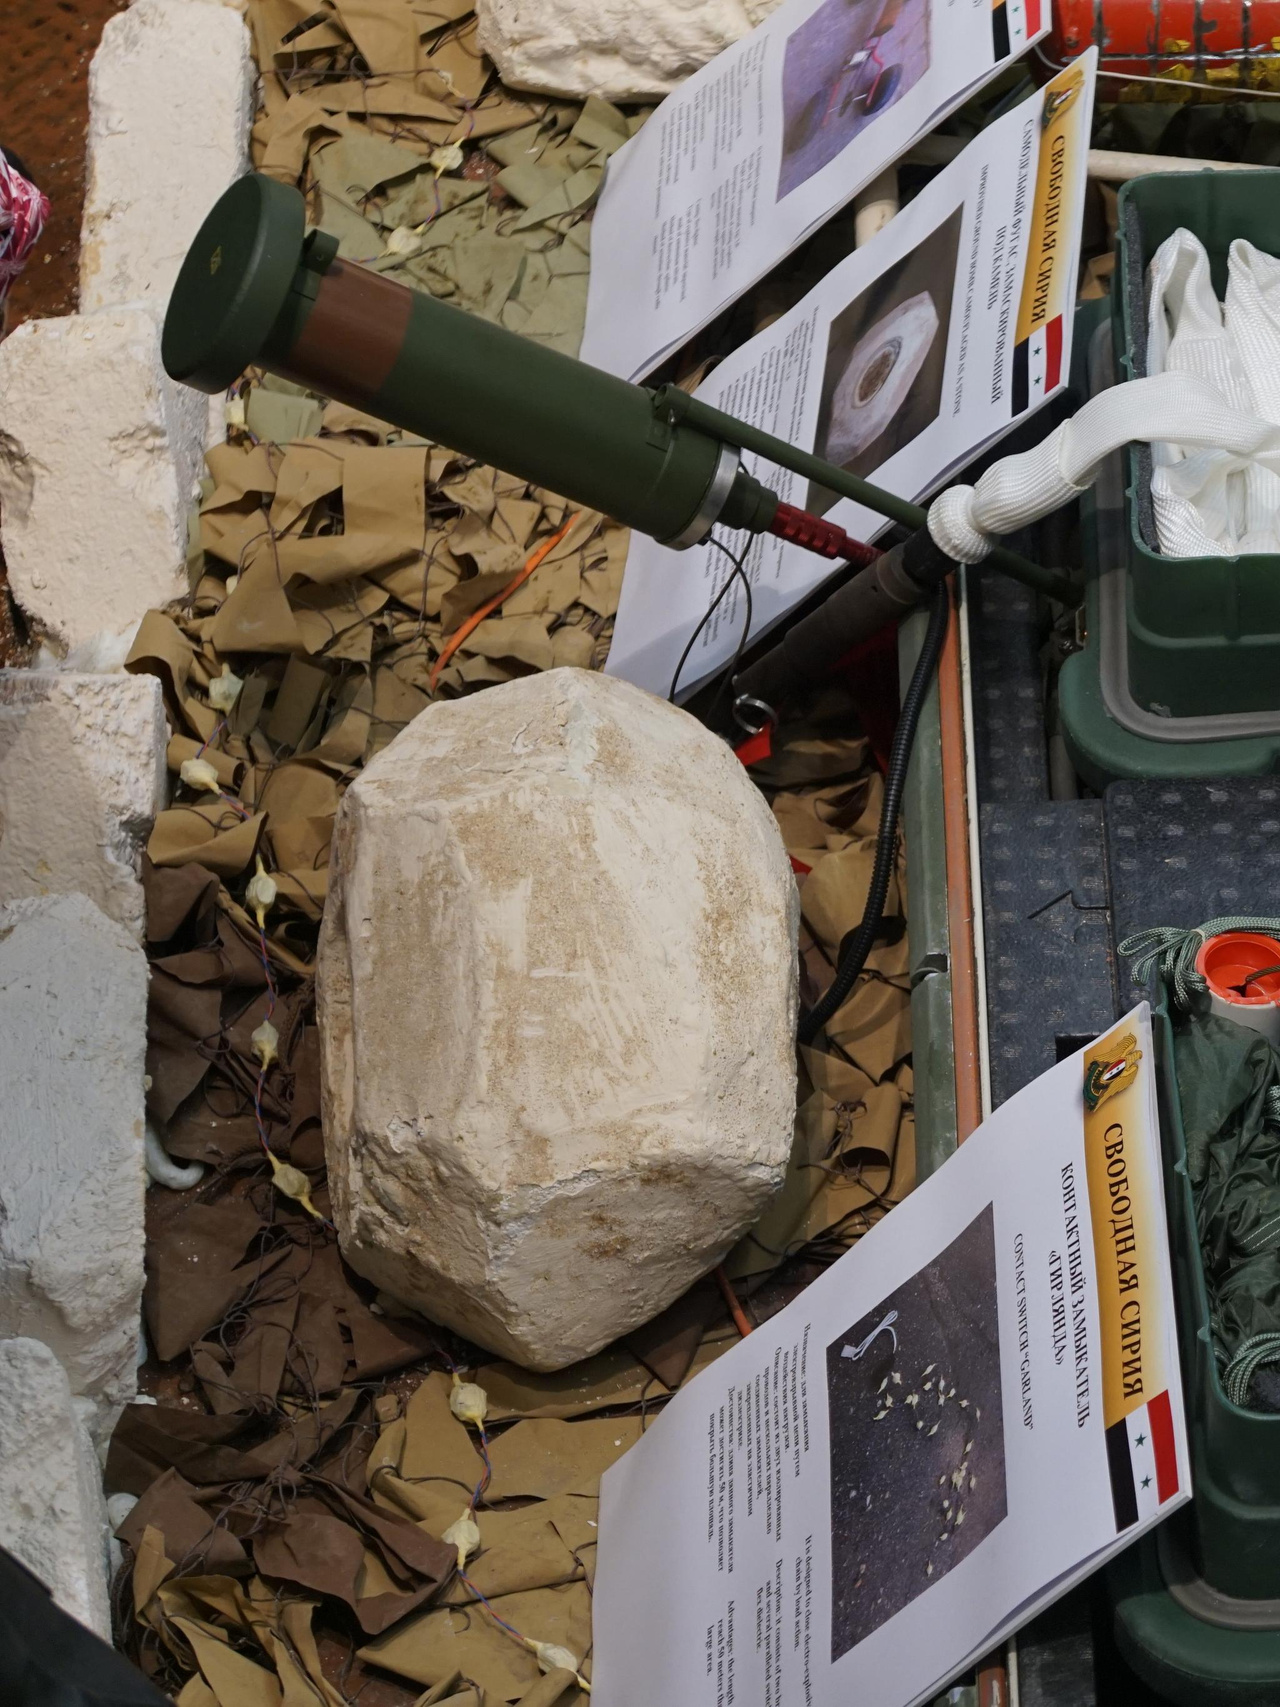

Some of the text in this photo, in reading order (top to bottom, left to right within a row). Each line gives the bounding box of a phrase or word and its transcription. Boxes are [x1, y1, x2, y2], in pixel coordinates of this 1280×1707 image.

[976, 164, 988, 220] IMPROVISED
[970, 220, 981, 260] GROUND
[1031, 135, 1065, 324] СВОБОДНАЯ СИРИЯ
[987, 225, 1007, 310] ПОД КАМЕНЬ
[990, 118, 1034, 405] САМОДЕЛЬНЫЙ ФУГАС, ЗАМАСКИРОВАННЫЙ
[959, 289, 974, 362] CAMOUFLAGED
[952, 384, 963, 418] STONE
[1104, 1122, 1144, 1400] СВОБОДНАЯ СИРИЯ
[1048, 1250, 1067, 1366] «ГИРЛЯНДА»
[1061, 1161, 1090, 1429] КОНТАКТНЫЙ ЗАМЫКАТЕЛЬ
[1013, 1232, 1033, 1430] CONTACT SWITCH “GARLAND”
[774, 1347, 782, 1394] Описание:
[800, 1323, 810, 1452] Назначение: для замыкания
[707, 1412, 716, 1453] покрыть
[707, 1454, 716, 1497] большую
[793, 1449, 801, 1478] путем
[719, 1481, 726, 1493] 50
[764, 1474, 772, 1534] параллельно
[774, 1468, 782, 1542] изолированных
[805, 1535, 812, 1544] It
[805, 1544, 812, 1555] is
[774, 1558, 783, 1616] Description:
[794, 1584, 802, 1596] by
[804, 1556, 812, 1594] designed
[775, 1617, 782, 1626] it
[804, 1609, 812, 1633] close
[805, 1597, 811, 1608] to
[706, 1625, 714, 1648] large
[726, 1600, 734, 1656] Advantages:
[756, 1608, 764, 1653] dielectric.
[717, 1648, 724, 1658] 50
[764, 1634, 772, 1681] paralleled
[775, 1664, 782, 1676] of
[726, 1672, 735, 1706] length
